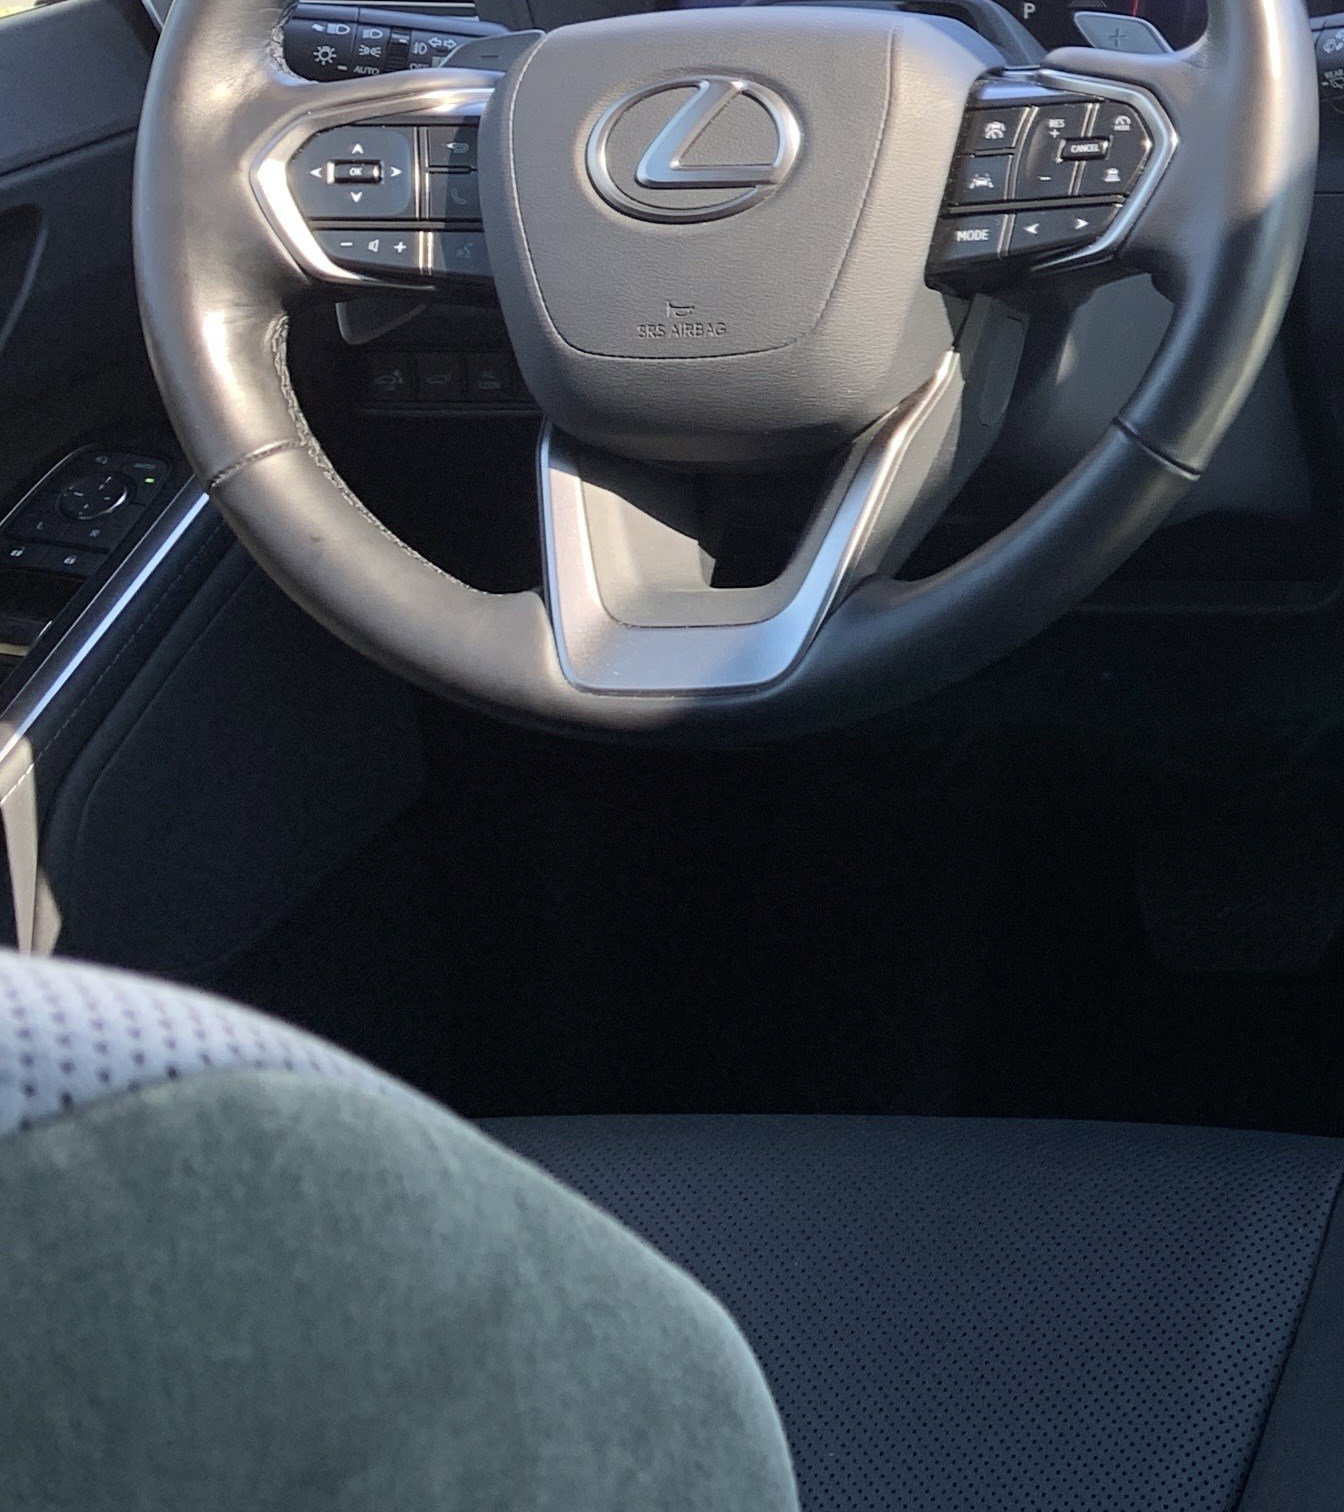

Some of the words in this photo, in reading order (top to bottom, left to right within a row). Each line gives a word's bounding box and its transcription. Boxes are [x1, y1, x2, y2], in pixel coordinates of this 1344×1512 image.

[1023, 3, 1037, 20] P
[353, 65, 380, 76] AUTO
[1049, 118, 1066, 128] RES
[1070, 143, 1100, 154] CANCEL
[956, 228, 990, 242] MODE
[638, 323, 666, 339] SRS
[671, 322, 727, 338] AIRBAG
